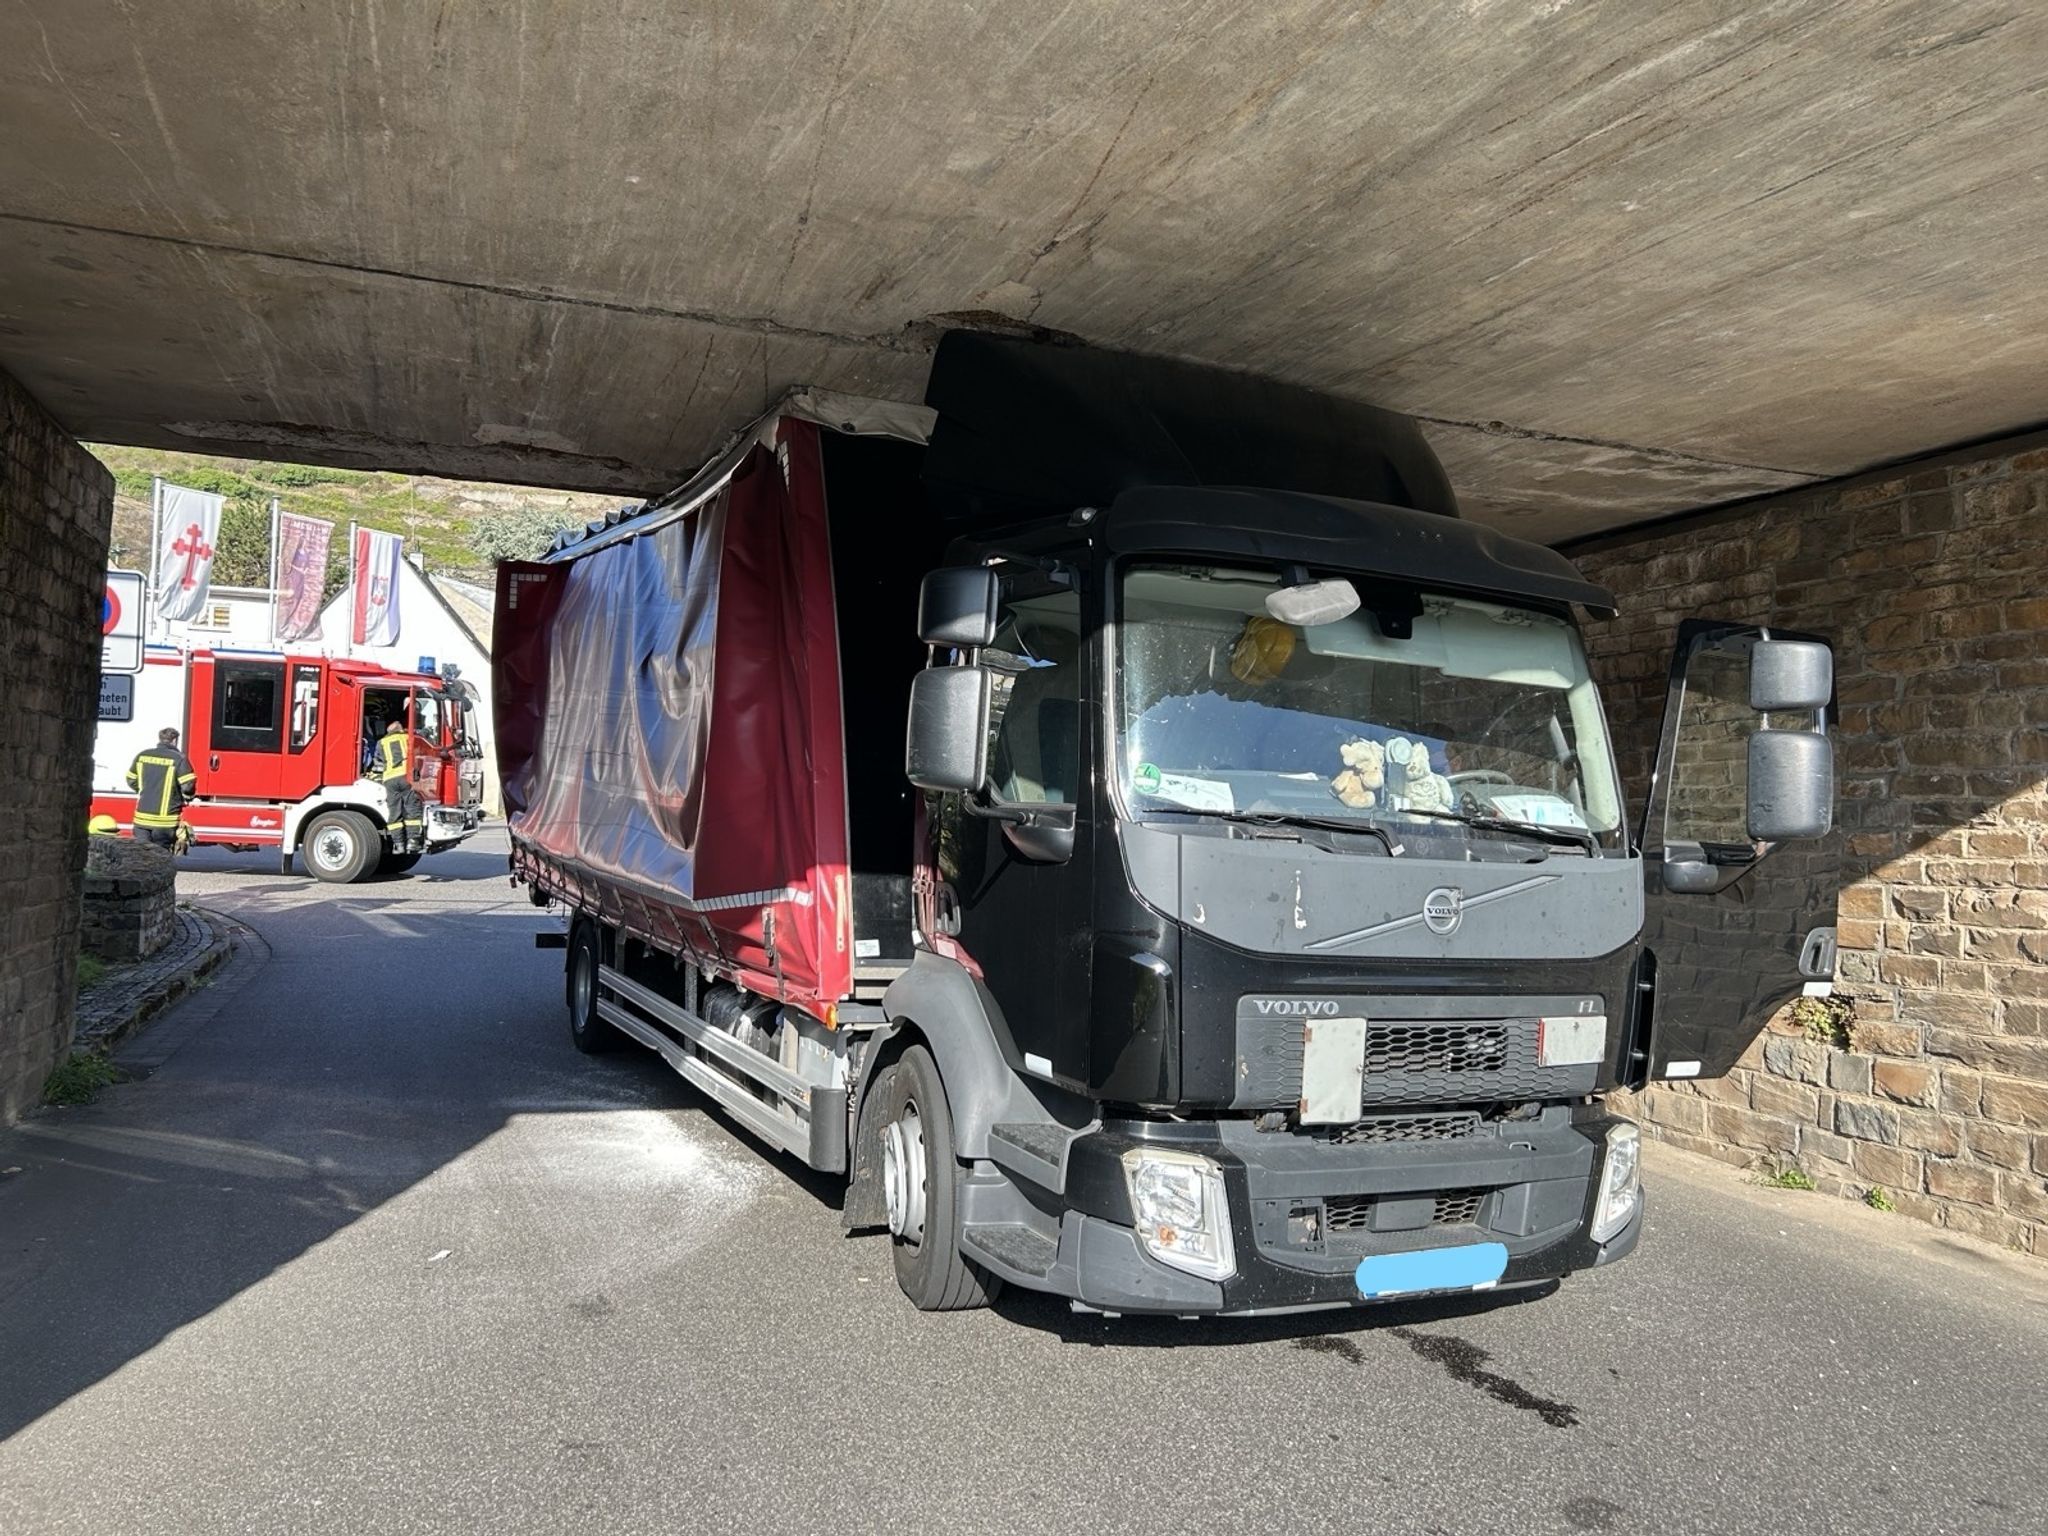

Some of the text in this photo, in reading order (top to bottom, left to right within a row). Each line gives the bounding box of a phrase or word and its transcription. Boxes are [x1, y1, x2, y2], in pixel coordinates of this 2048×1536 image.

[1144, 765, 1151, 778] 4
[1427, 907, 1460, 916] VOLVO
[1253, 1000, 1340, 1016] VOLVO
[1578, 1000, 1599, 1014] FL
